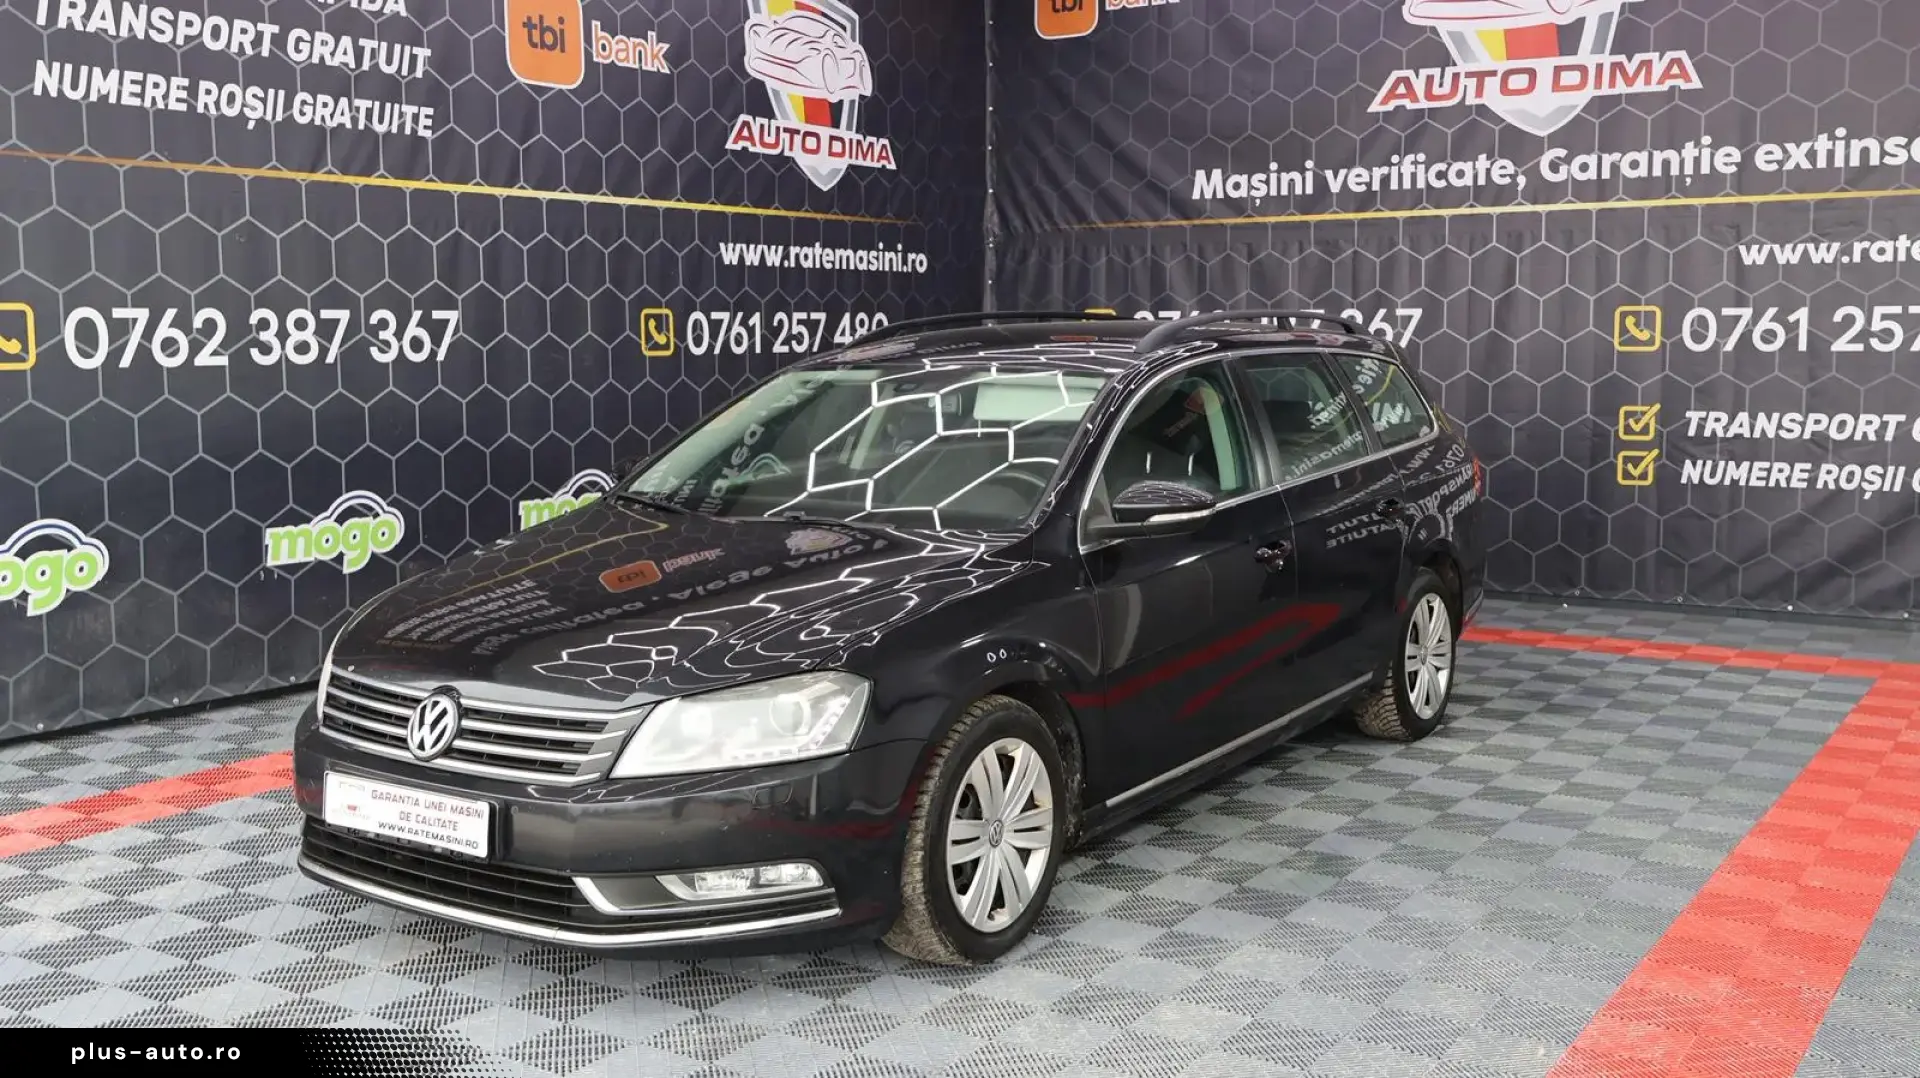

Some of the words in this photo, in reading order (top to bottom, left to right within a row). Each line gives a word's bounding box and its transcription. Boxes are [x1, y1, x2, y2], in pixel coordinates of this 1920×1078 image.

[36, 0, 279, 58] TRANSPORT
[287, 28, 431, 79] GRATUIT
[522, 16, 565, 53] tbi
[592, 21, 670, 74] bank
[33, 60, 189, 112] NUMERE
[197, 80, 285, 130] ROȘII
[293, 92, 434, 138] GRATUITE
[1379, 63, 1538, 106] AUTO
[1550, 55, 1695, 93] DIMA
[731, 117, 821, 156] AUTO
[827, 134, 895, 167] DIMA
[1193, 161, 1314, 206] Mașini
[1325, 151, 1526, 193] verificate,
[1539, 138, 1742, 187] Garanție
[720, 241, 927, 275] www.ratemasini.ro
[63, 307, 229, 369] 0762
[249, 308, 350, 365] 387
[368, 310, 459, 364] 367
[687, 311, 762, 356] 0761
[772, 311, 827, 353] 257
[1682, 306, 1809, 352] 0761
[1685, 411, 1906, 443] TRANSPORT
[1680, 460, 1815, 489] NUMERE
[1816, 464, 1906, 500] ROȘII
[268, 517, 400, 572] mogo
[371, 789, 420, 808] GARANTIA
[424, 799, 448, 813] UNEI
[449, 804, 485, 820] MASINI
[399, 810, 412, 823] DE
[415, 812, 459, 832] CALITATE
[377, 820, 480, 850] WWW.RATEMASINI.RO
